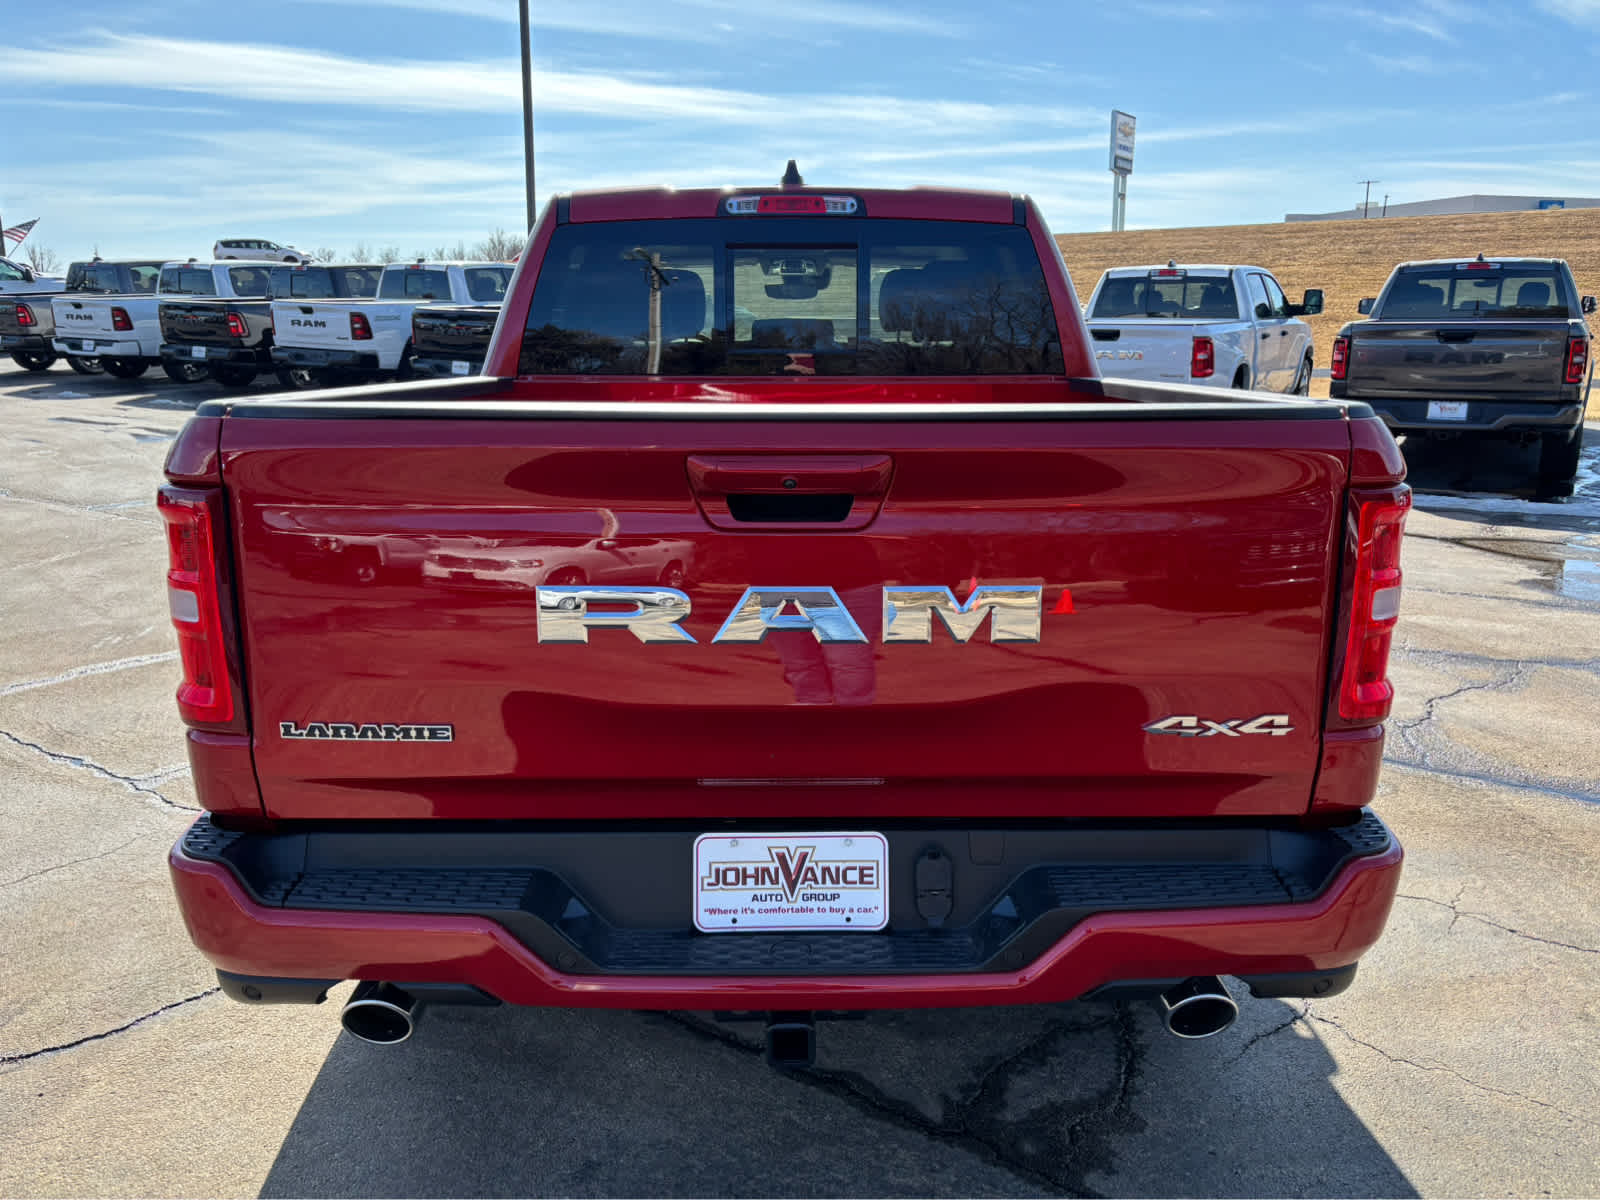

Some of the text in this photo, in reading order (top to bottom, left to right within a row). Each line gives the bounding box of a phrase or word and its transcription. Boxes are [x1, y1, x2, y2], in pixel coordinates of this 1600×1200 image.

[290, 319, 327, 328] RAM
[1095, 350, 1144, 361] AM
[536, 585, 1043, 643] RAM
[279, 722, 453, 742] LARAMIE
[1143, 714, 1295, 737] 4x4
[707, 850, 875, 899] JOHN VANCE
[751, 892, 841, 902] AUTO GROUP
[741, 906, 756, 915] it's
[758, 906, 814, 914] comfortable
[816, 905, 827, 914] to
[829, 905, 846, 915] buy
[848, 906, 855, 914] a
